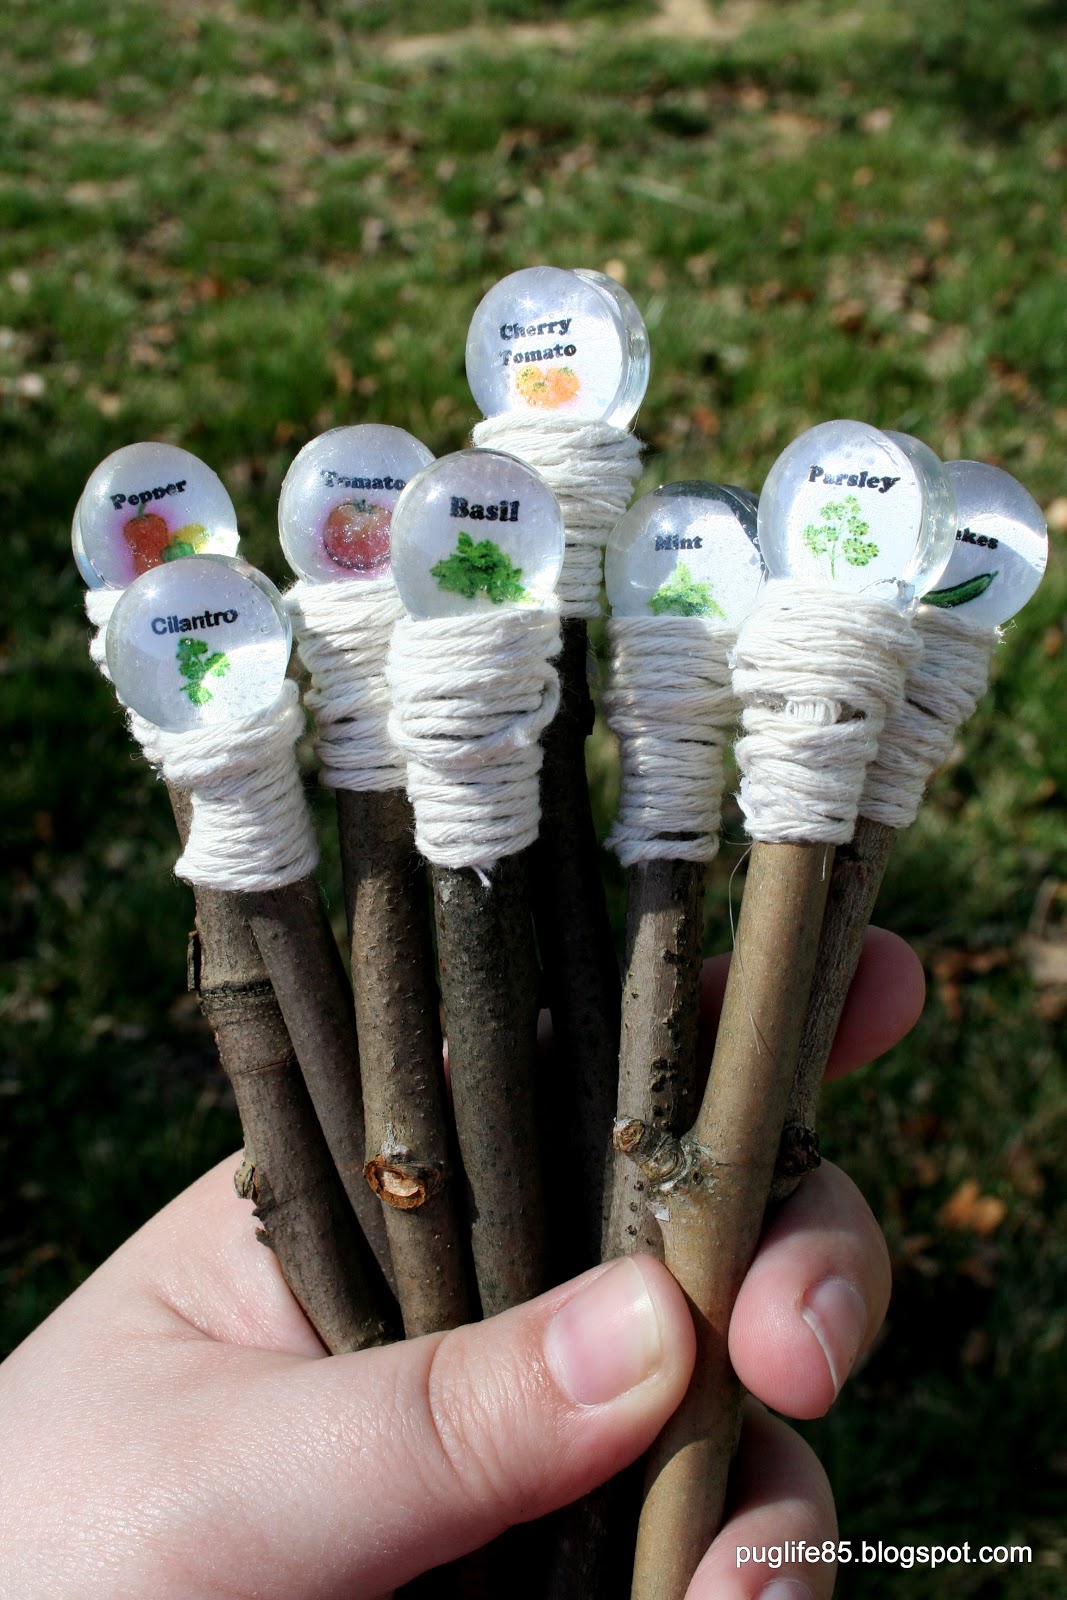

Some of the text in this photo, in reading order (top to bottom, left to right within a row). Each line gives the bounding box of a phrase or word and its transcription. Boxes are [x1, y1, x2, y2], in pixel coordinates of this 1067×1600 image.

[499, 318, 572, 340] Cherry
[499, 343, 577, 366] Tomato
[320, 469, 407, 490] Tomato
[808, 465, 901, 494] Parsley
[110, 479, 187, 511] Pepper
[450, 496, 520, 522] Basil
[654, 534, 703, 552] Mint
[151, 608, 239, 636] Cilantro
